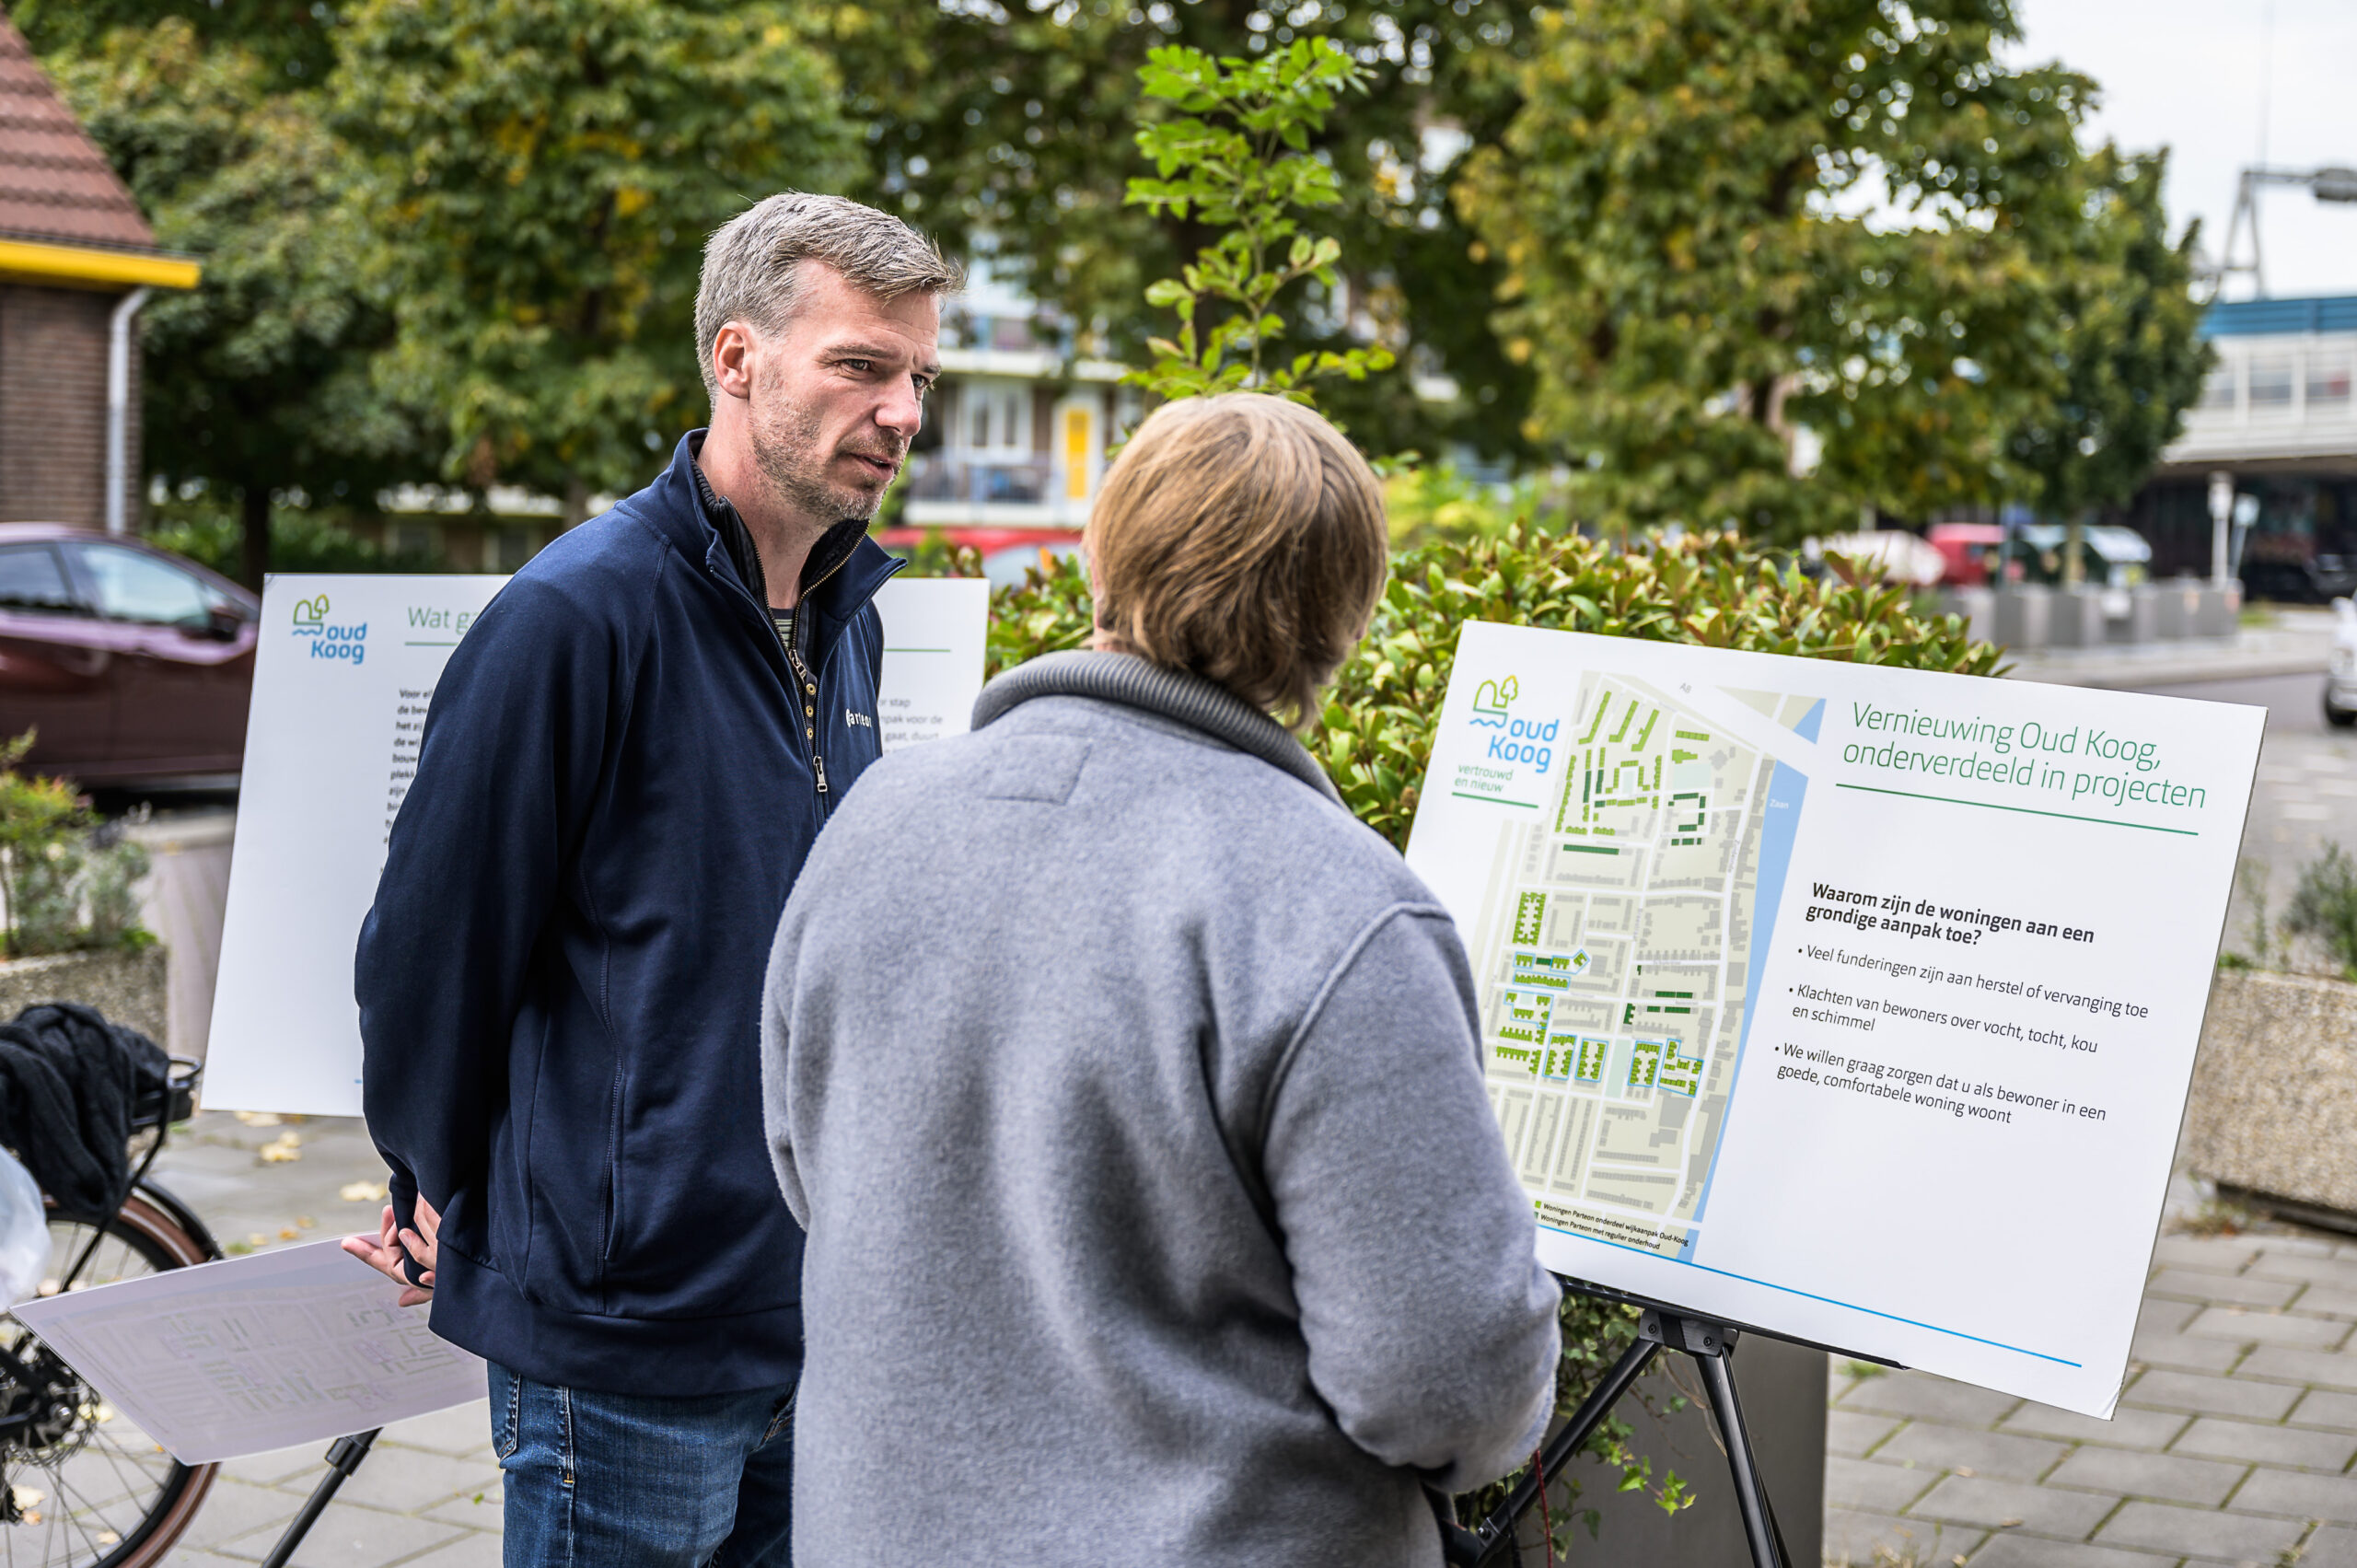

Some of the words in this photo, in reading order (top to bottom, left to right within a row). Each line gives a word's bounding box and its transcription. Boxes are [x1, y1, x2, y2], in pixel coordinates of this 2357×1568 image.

[327, 622, 367, 641] oud
[408, 606, 449, 629] Wat
[311, 640, 365, 665] Koog
[1510, 718, 1560, 742] oud
[1854, 702, 2014, 754] Vernieuwing
[2021, 722, 2078, 753] Oud
[2085, 729, 2160, 772] Koog,
[1457, 764, 1515, 782] vertrouwd
[1488, 735, 1552, 773] Koog
[1454, 777, 1469, 788] en
[1470, 778, 1504, 793] nieuw
[1844, 741, 2035, 785] onderverdeeld
[2041, 762, 2065, 790] in
[2072, 772, 2205, 808] projecten
[1805, 906, 1877, 931] grondige
[1881, 918, 1942, 939] aanpak
[1946, 926, 1981, 945] toe?
[1813, 882, 1877, 906] Waarom
[1881, 895, 1910, 915] zijn
[1915, 900, 1935, 916] de
[1940, 907, 2022, 933] woningen
[2026, 922, 2058, 937] aan
[2062, 927, 2094, 943] een
[1807, 945, 1834, 961] Veel
[1837, 949, 1916, 977] funderingen
[1920, 966, 1944, 983] zijn
[1947, 973, 1972, 986] aan
[1976, 974, 2024, 995] herstel
[2026, 985, 2043, 998] of
[2044, 989, 2122, 1017] vervanging
[2126, 1003, 2149, 1018] toe
[1793, 1006, 1808, 1018] en
[1811, 1009, 1875, 1031] schimmel
[1797, 984, 1852, 1006] Klachten
[1856, 998, 1879, 1011] van
[1883, 999, 1947, 1024] bewoners
[1951, 1016, 1981, 1030] over
[1984, 1022, 2024, 1041] vocht,
[2028, 1028, 2066, 1050] tocht,
[2072, 1035, 2097, 1052] kou
[1777, 1066, 1819, 1086] goede,
[1824, 1075, 1911, 1102] comfortabele
[1915, 1094, 1965, 1117] woning
[1968, 1105, 2012, 1123] woont
[1784, 1042, 1804, 1059] We
[1807, 1050, 1844, 1067] willen
[1846, 1060, 1885, 1079] graag
[1887, 1067, 1933, 1086] zorgen
[1936, 1074, 1959, 1090] dat
[1962, 1083, 1970, 1093] u
[1974, 1083, 1993, 1098] als
[1997, 1086, 2060, 1110] bewoner
[2062, 1099, 2075, 1114] in
[2079, 1107, 2106, 1121] een
[1540, 1214, 1569, 1226] Woningen
[1570, 1221, 1592, 1232] Parteon
[1593, 1227, 1605, 1236] met
[1605, 1230, 1627, 1240] regulier
[1628, 1237, 1661, 1249] onderhoud
[1543, 1203, 1572, 1215] Woningen
[1573, 1210, 1595, 1222] Parteon
[1596, 1216, 1625, 1229] onderdeel
[1626, 1224, 1658, 1237] wijkaanpak
[1660, 1232, 1689, 1248] Oud-Koog
